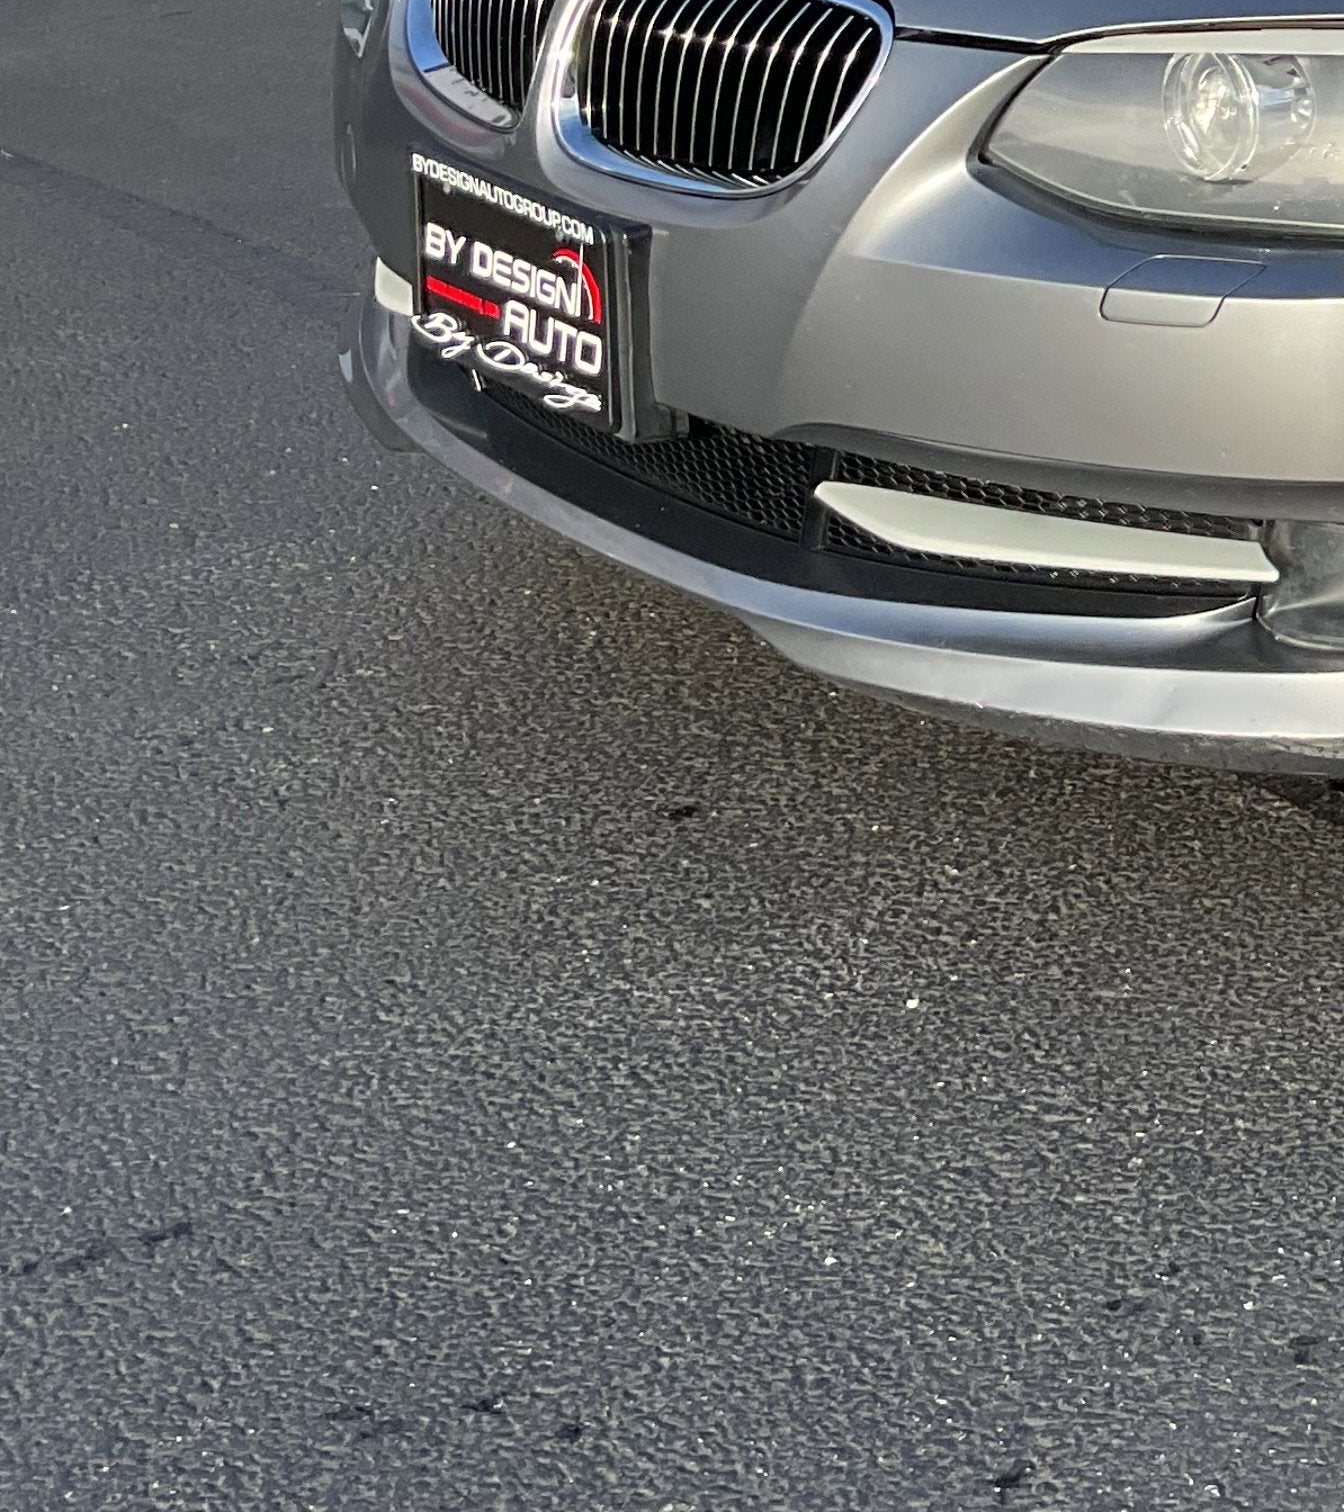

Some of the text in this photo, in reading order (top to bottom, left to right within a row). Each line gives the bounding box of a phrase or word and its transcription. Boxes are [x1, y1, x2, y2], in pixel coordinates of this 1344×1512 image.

[411, 152, 594, 246] BYDESIGNAUTOGROUP.COM
[424, 222, 581, 316] BY DESIGN
[411, 312, 475, 359] By
[503, 299, 602, 376] AUTO
